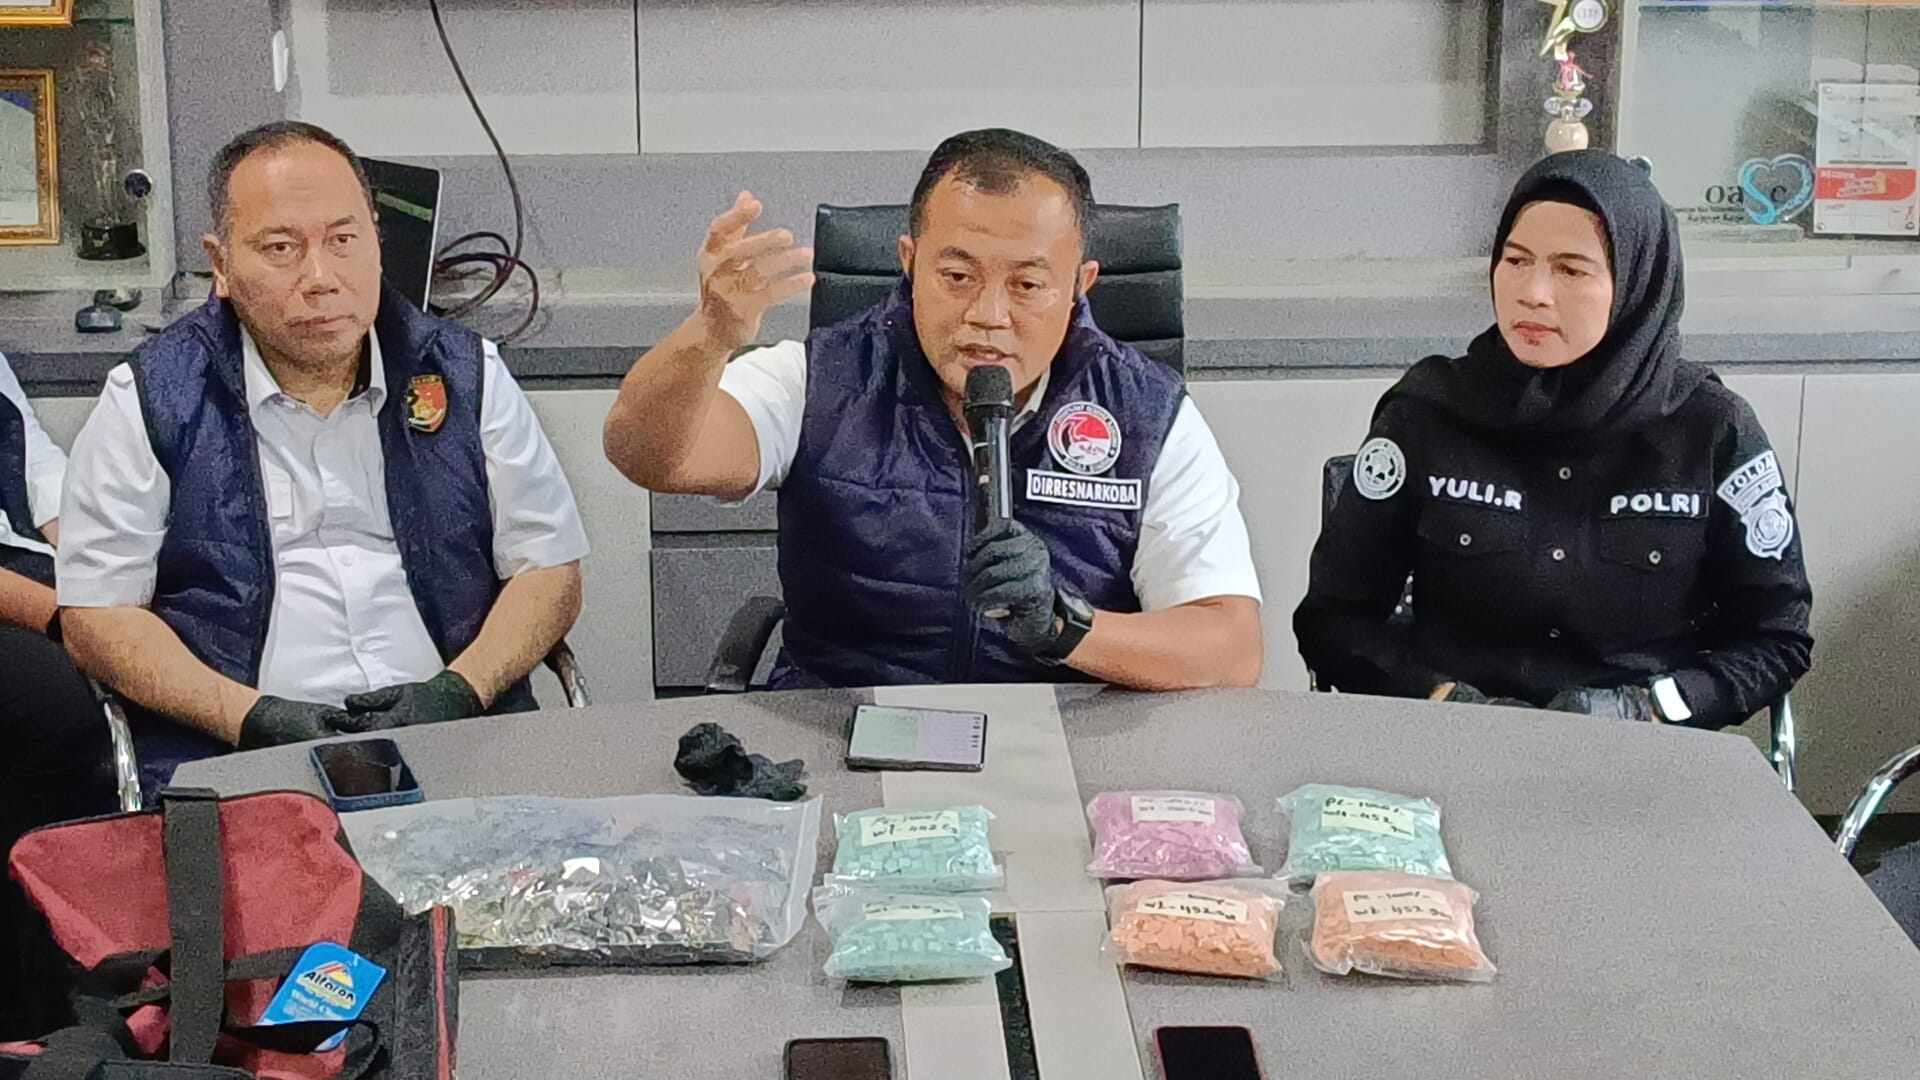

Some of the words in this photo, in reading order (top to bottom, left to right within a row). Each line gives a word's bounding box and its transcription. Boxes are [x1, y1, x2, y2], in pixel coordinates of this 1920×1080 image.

[1032, 476, 1136, 503] DIRRESNARKOBA
[1723, 453, 1774, 499] POLDA
[1428, 476, 1522, 511] YULI.R
[1610, 493, 1700, 517] POLRI
